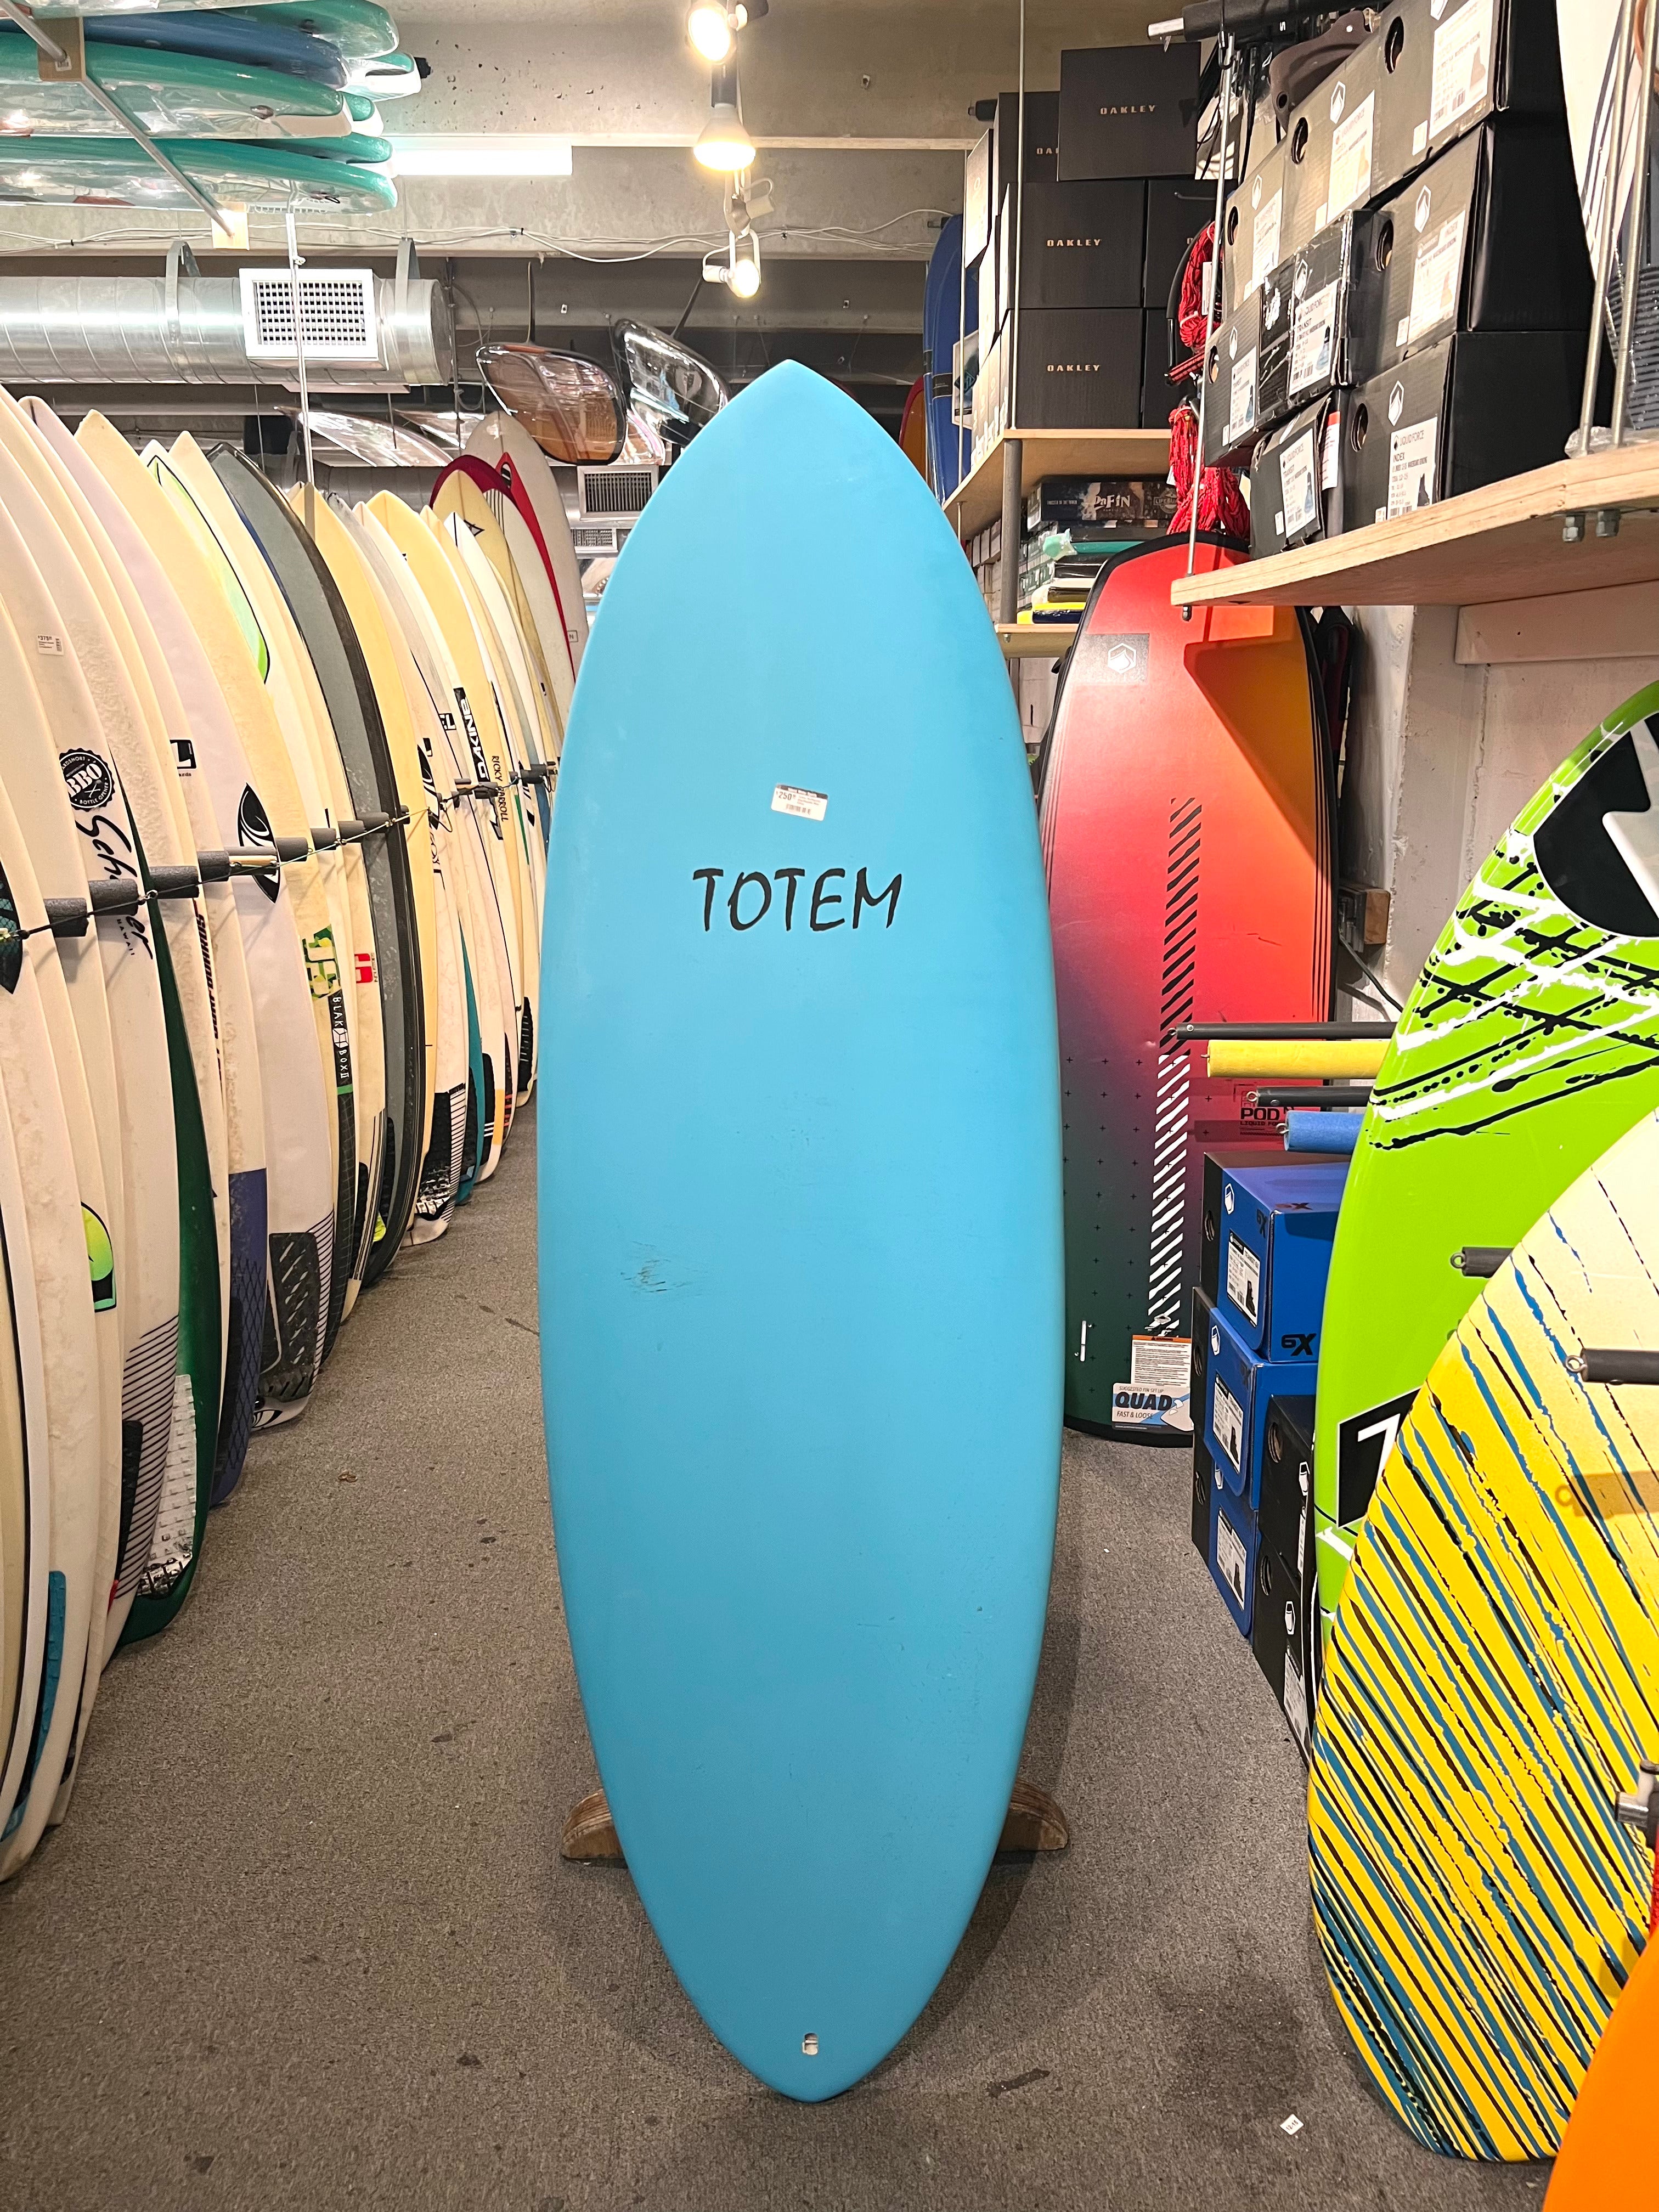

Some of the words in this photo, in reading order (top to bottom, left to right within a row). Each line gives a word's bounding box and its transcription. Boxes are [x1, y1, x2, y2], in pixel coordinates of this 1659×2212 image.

[1099, 104, 1156, 115] OAKLEY
[1046, 239, 1102, 247] OAKLEY
[1047, 364, 1100, 373] OAKLEY
[461, 697, 488, 780] DAKINE
[492, 755, 503, 782] RICKY
[80, 797, 99, 805] BOTTLE
[98, 781, 109, 800] OPENER
[692, 867, 902, 932] TOTEM
[116, 918, 136, 956] HAWAII
[332, 997, 344, 1028] BLAK
[1240, 1108, 1280, 1121] POD
[1280, 1333, 1317, 1356] 6X
[1115, 1392, 1173, 1411] QUAD
